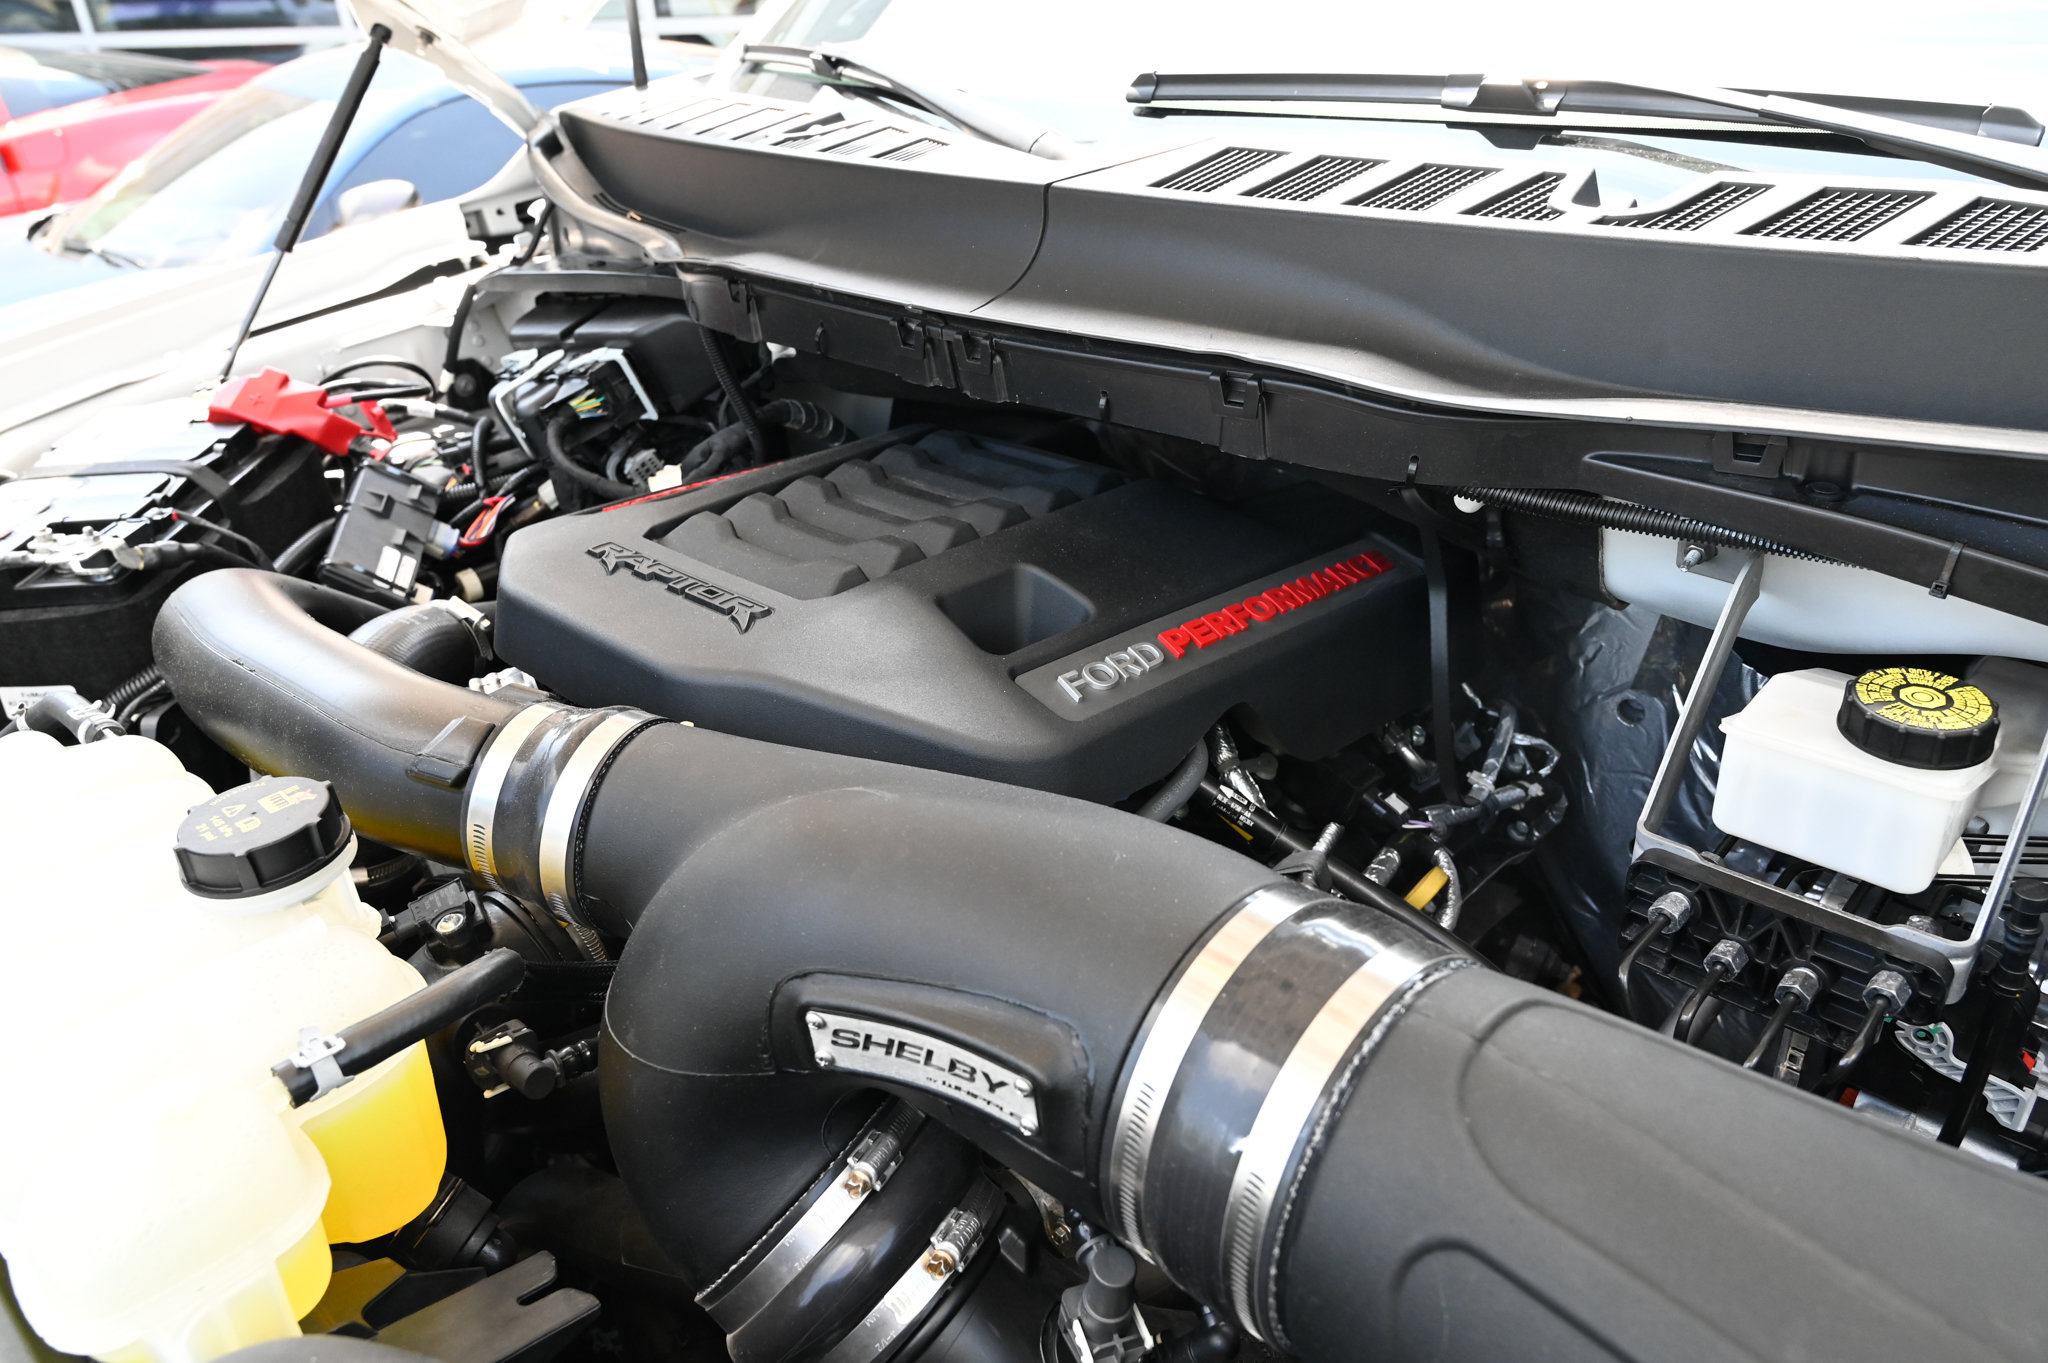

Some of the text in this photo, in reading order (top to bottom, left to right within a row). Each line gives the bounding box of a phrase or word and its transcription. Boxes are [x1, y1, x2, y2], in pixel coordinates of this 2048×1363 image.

[585, 542, 775, 635] RAPTOR
[1057, 550, 1396, 703] FORD PERFORMANCE
[830, 1028, 1009, 1094] SHELBY
